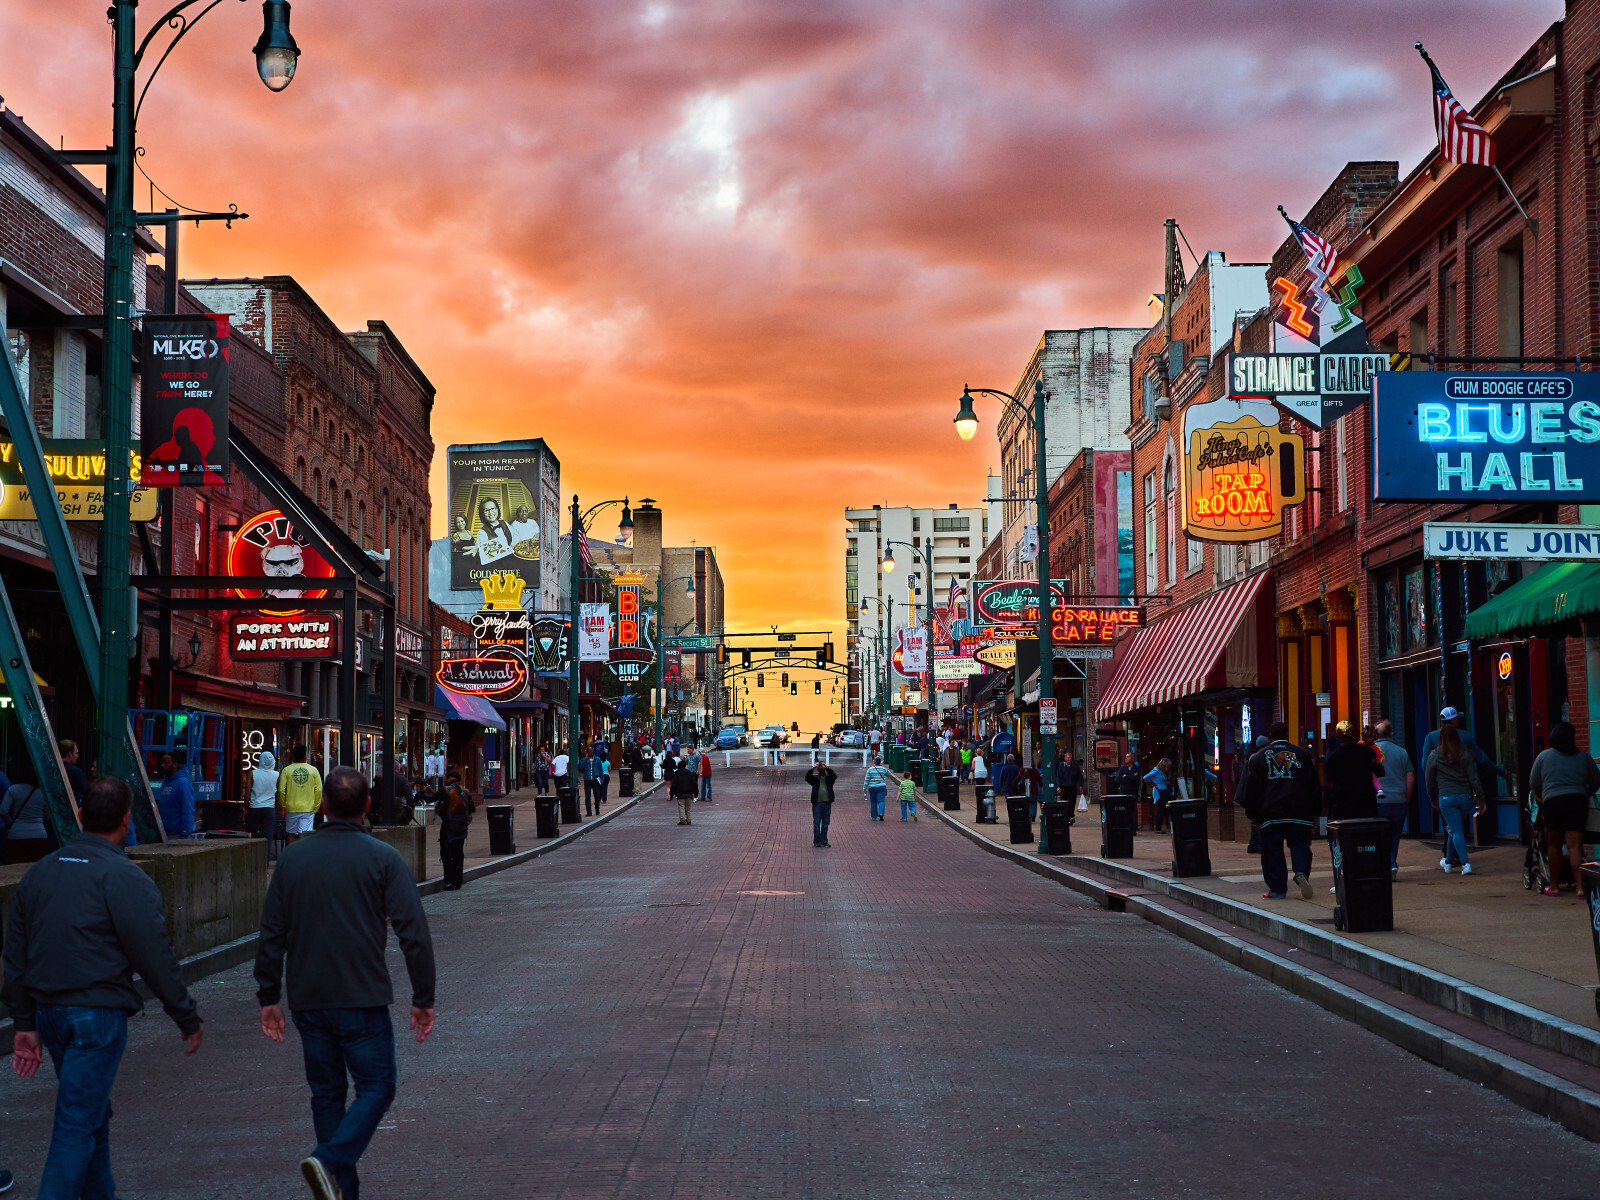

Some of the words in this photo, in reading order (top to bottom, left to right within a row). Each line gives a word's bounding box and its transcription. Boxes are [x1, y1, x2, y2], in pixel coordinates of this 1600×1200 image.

[153, 339, 219, 360] MLK50
[160, 372, 193, 380] WHERE
[1234, 356, 1316, 392] STRANGE
[169, 381, 184, 389] WE
[185, 381, 200, 389] GO
[1454, 381, 1479, 394] RUM
[1482, 381, 1524, 394] BOOGIE
[1527, 381, 1565, 394] CAFE'S
[156, 390, 183, 398] FROM
[184, 390, 213, 398] HERE?
[1418, 401, 1600, 443] BLUES
[1204, 436, 1242, 455] Kings
[501, 457, 537, 465] RESORT
[1197, 453, 1238, 471] Palace
[1437, 452, 1583, 491] HALL
[1215, 474, 1265, 493] TAP
[1196, 491, 1270, 515] ROOM
[1439, 530, 1509, 552] JUKE
[469, 569, 492, 579] GOLD
[585, 616, 589, 626] I
[590, 616, 604, 626] AM
[1028, 607, 1074, 621] KIG'S
[236, 624, 283, 634] PORK
[288, 621, 330, 633] WITH
[1052, 626, 1113, 640] CAFE
[237, 639, 257, 651] AN
[259, 636, 330, 650] ATTITUDE!
[396, 627, 422, 660] CHWAB
[907, 637, 910, 645] I
[911, 637, 923, 645] AM
[459, 662, 515, 680] Schwab
[618, 664, 640, 675] BLUES
